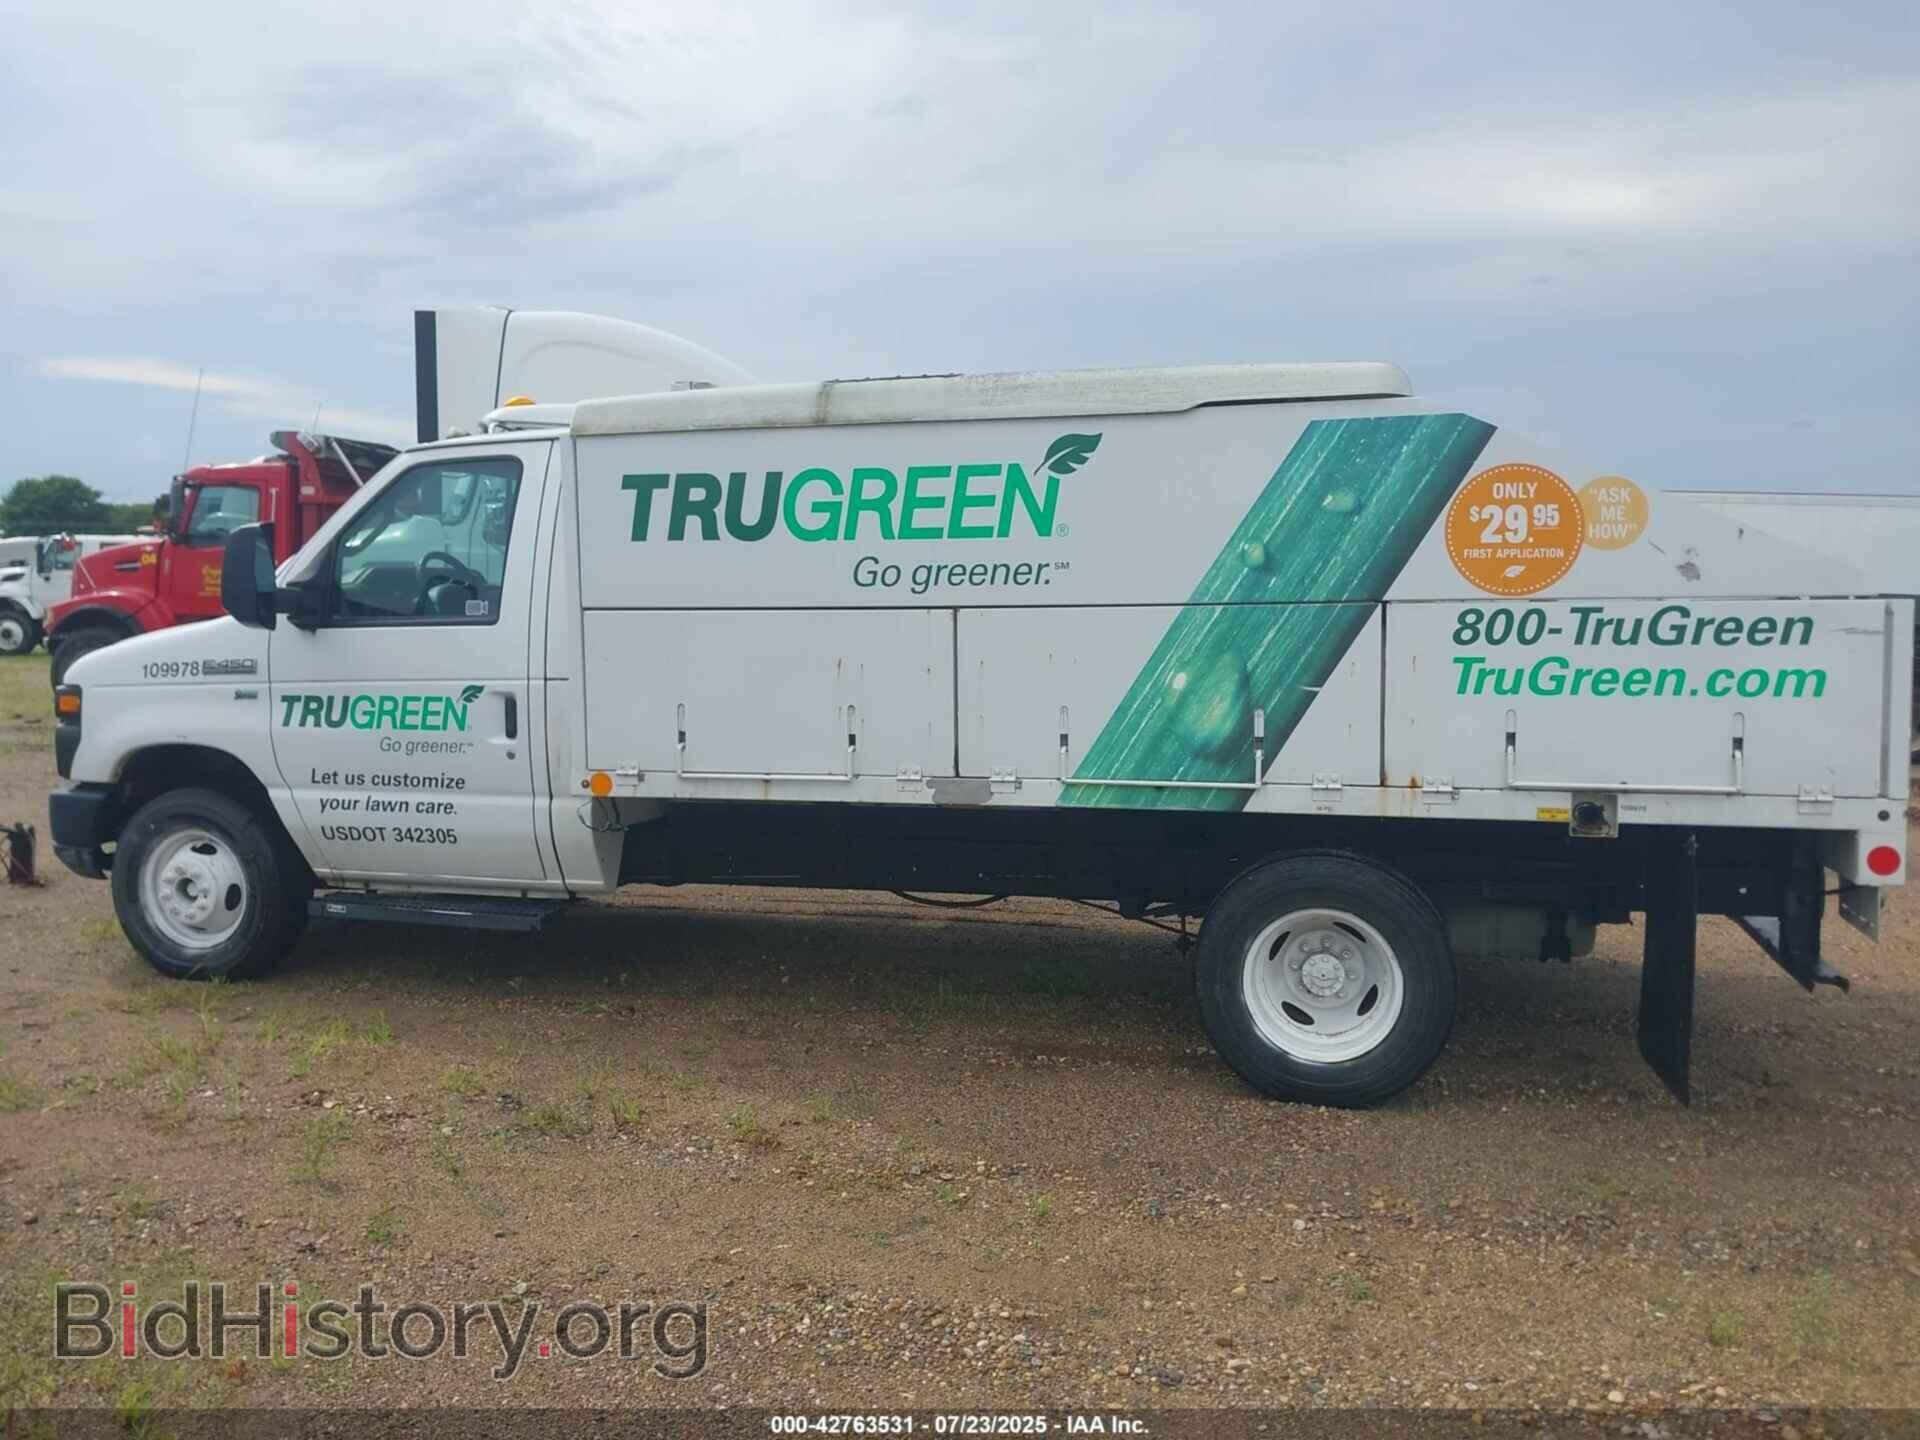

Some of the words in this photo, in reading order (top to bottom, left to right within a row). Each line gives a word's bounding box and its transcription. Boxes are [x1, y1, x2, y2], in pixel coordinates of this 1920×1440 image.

[1492, 483, 1538, 499] ONLY
[1600, 506, 1626, 521] ME
[1464, 549, 1492, 559] FIRST
[1496, 548, 1564, 559] APPLICATION
[853, 556, 901, 588] Go
[910, 561, 1051, 595] greener.
[1452, 605, 1815, 647] 800-TruGreen
[143, 660, 200, 678] 109978
[1453, 656, 1827, 698] TruGreen.com
[281, 695, 468, 731] TRUGREEN
[380, 736, 402, 752] Go
[406, 741, 467, 756] greener.
[311, 768, 339, 785] Let
[345, 773, 365, 786] us
[371, 772, 466, 790] customize
[320, 796, 360, 813] your
[365, 795, 409, 813] lawn
[415, 801, 458, 815] care.
[321, 826, 386, 842] USDOT
[392, 826, 458, 844] 342305
